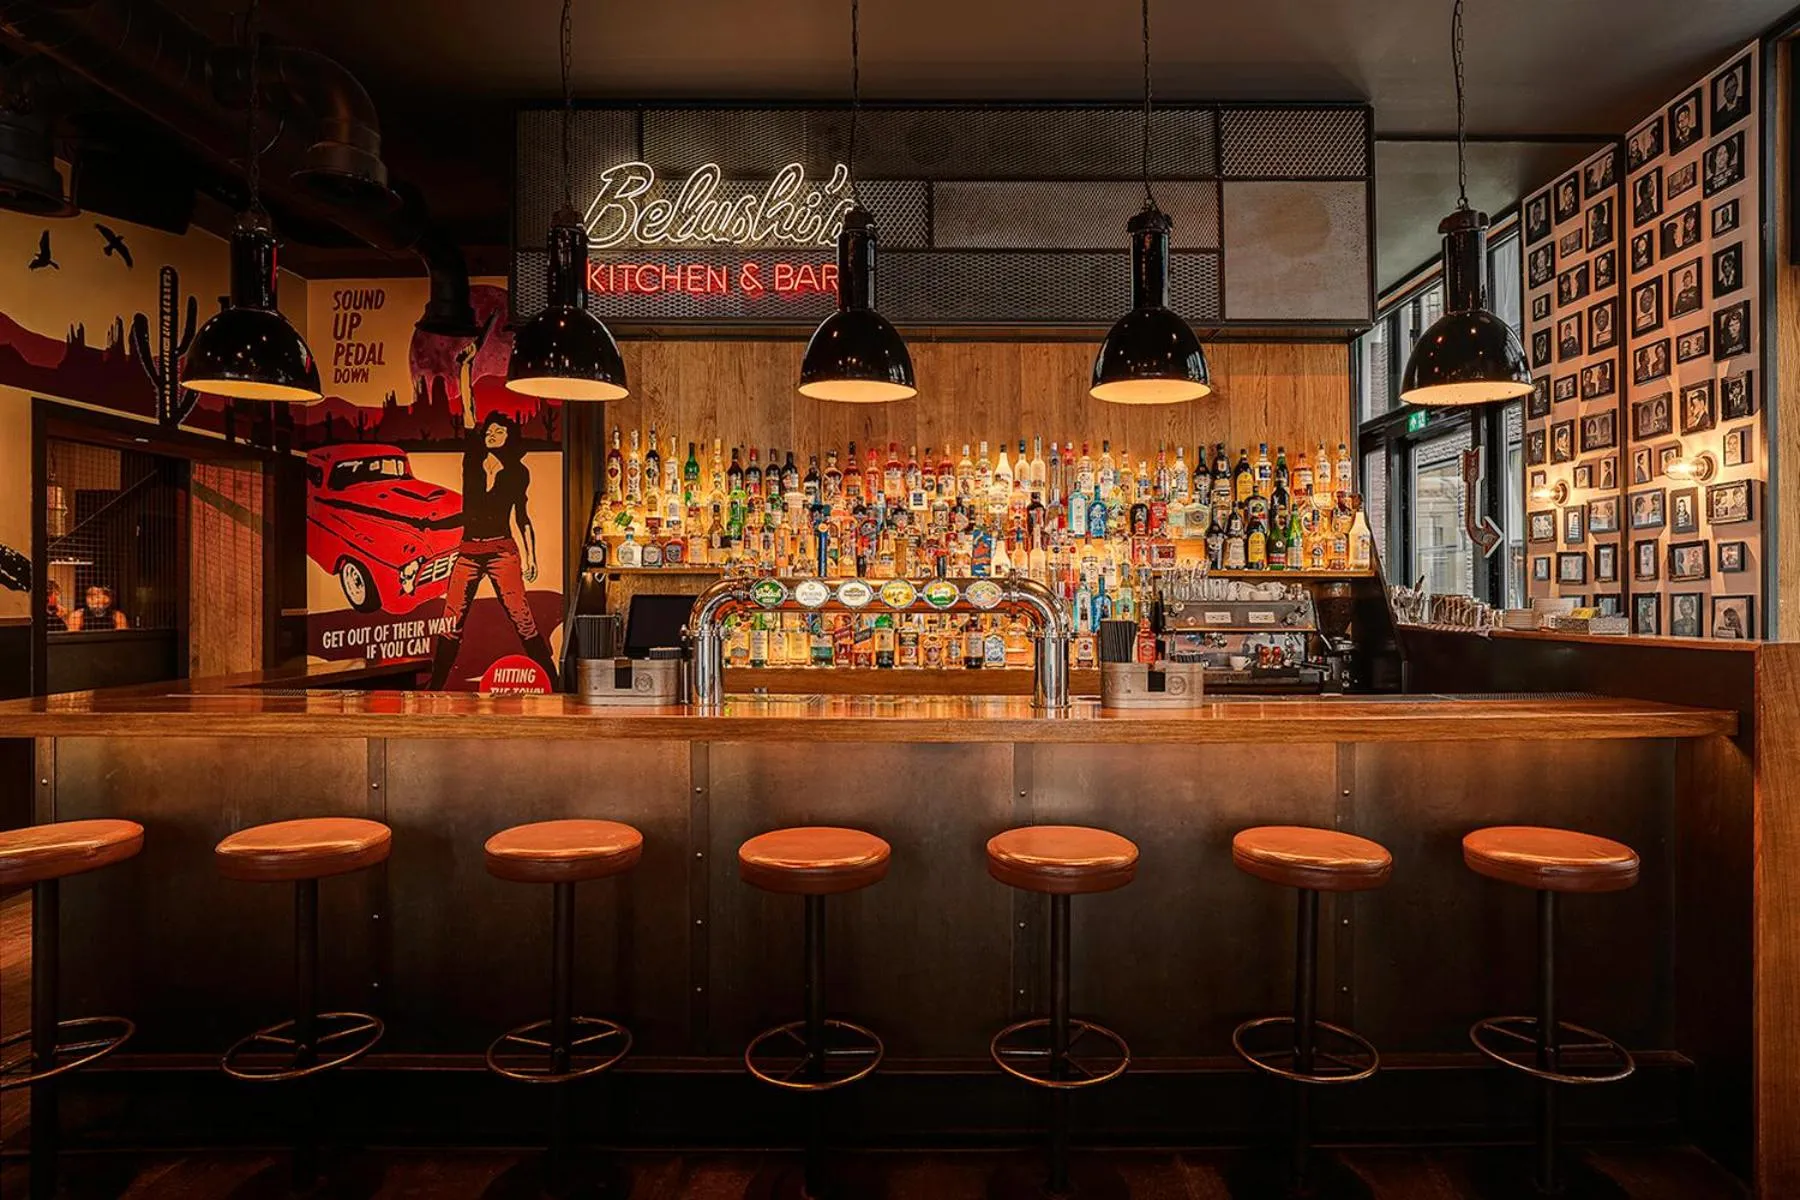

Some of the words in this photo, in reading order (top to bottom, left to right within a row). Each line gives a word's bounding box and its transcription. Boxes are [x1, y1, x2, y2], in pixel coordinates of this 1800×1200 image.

[584, 161, 855, 248] Belushi's
[586, 262, 728, 293] KITCHEN
[739, 262, 764, 292] &
[774, 263, 839, 292] BAR
[333, 288, 385, 311] SOUND
[333, 312, 362, 341] UP
[333, 342, 386, 366] PEDAL
[333, 367, 370, 384] DOWN
[322, 630, 345, 649] GET
[347, 626, 372, 646] OUT
[373, 624, 390, 642] OF
[392, 620, 425, 640] THEIR
[428, 615, 457, 635] WAY!
[366, 644, 377, 659] IF
[380, 640, 404, 659] YOU
[407, 637, 431, 656] CAN
[493, 668, 536, 684] HITTING
